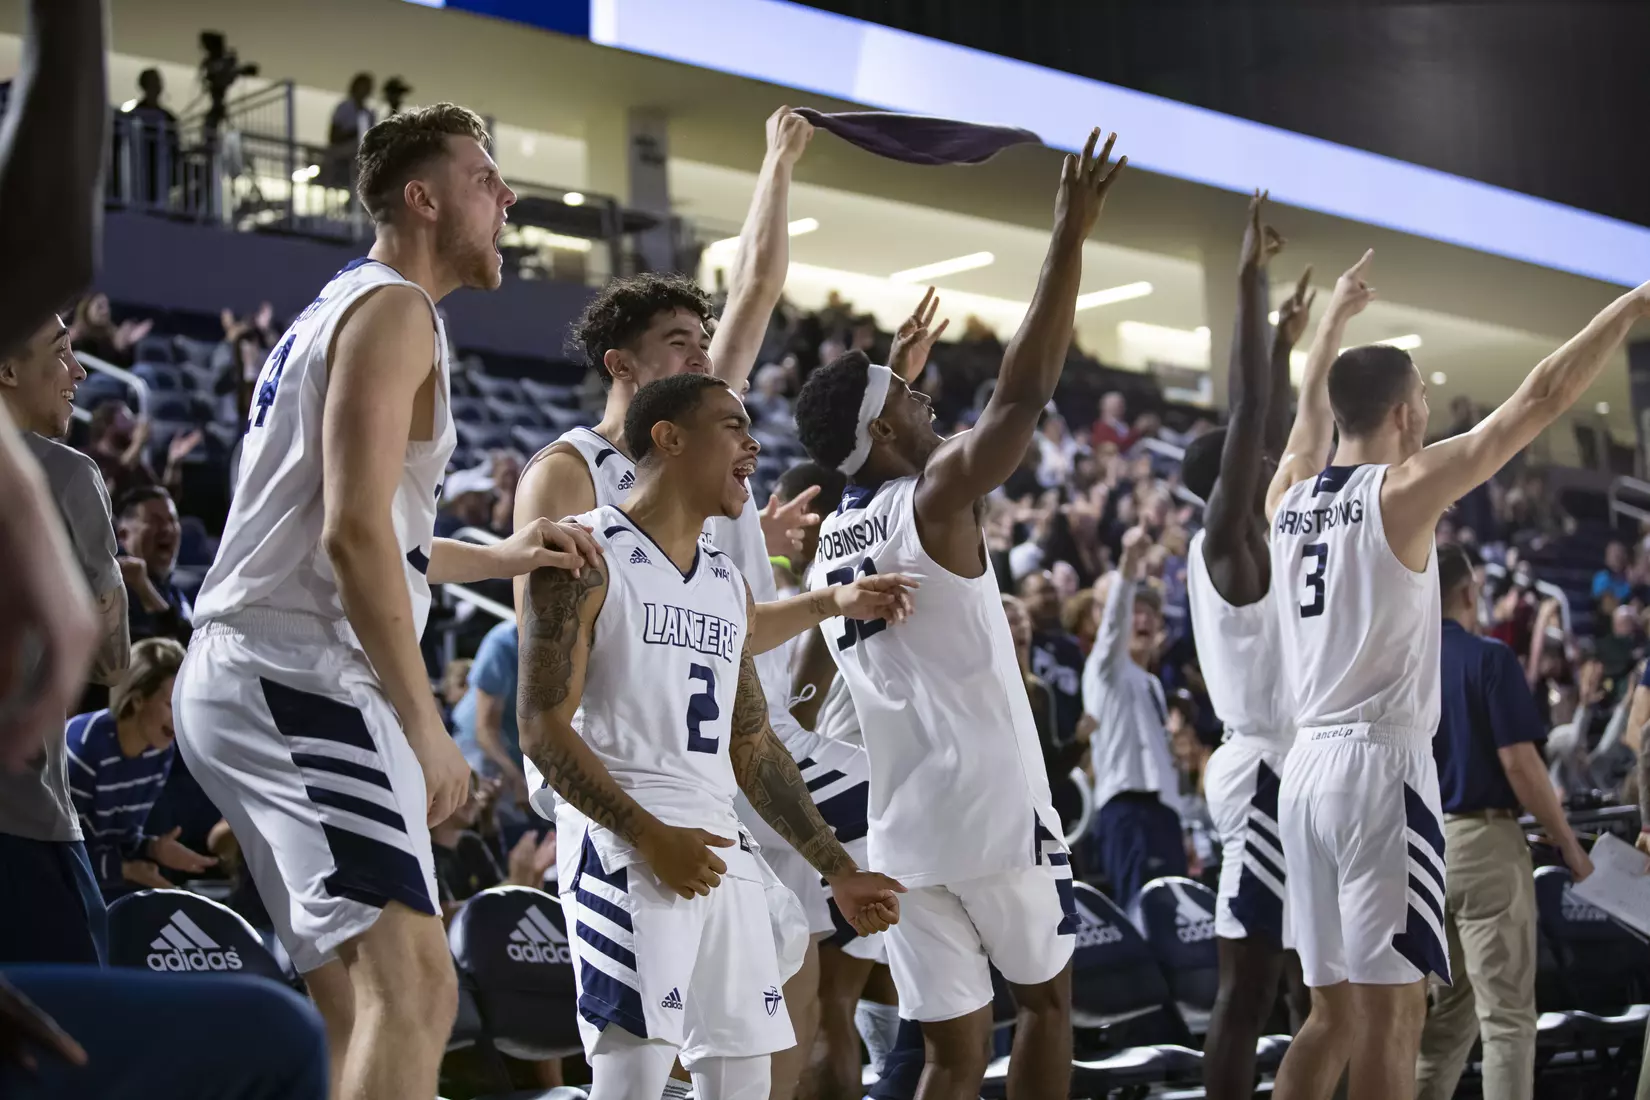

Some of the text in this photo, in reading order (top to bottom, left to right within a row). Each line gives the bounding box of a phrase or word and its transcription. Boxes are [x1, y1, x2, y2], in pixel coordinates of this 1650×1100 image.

[617, 481, 634, 491] adi
[818, 515, 887, 563] ROBINSON
[1300, 542, 1328, 618] 3
[643, 602, 738, 663] LANCERS
[686, 662, 720, 754] 2
[1076, 922, 1123, 948] didas
[1176, 920, 1216, 943] adid
[146, 947, 243, 972] adidas
[506, 940, 573, 964] adida
[661, 1000, 683, 1010] adida
